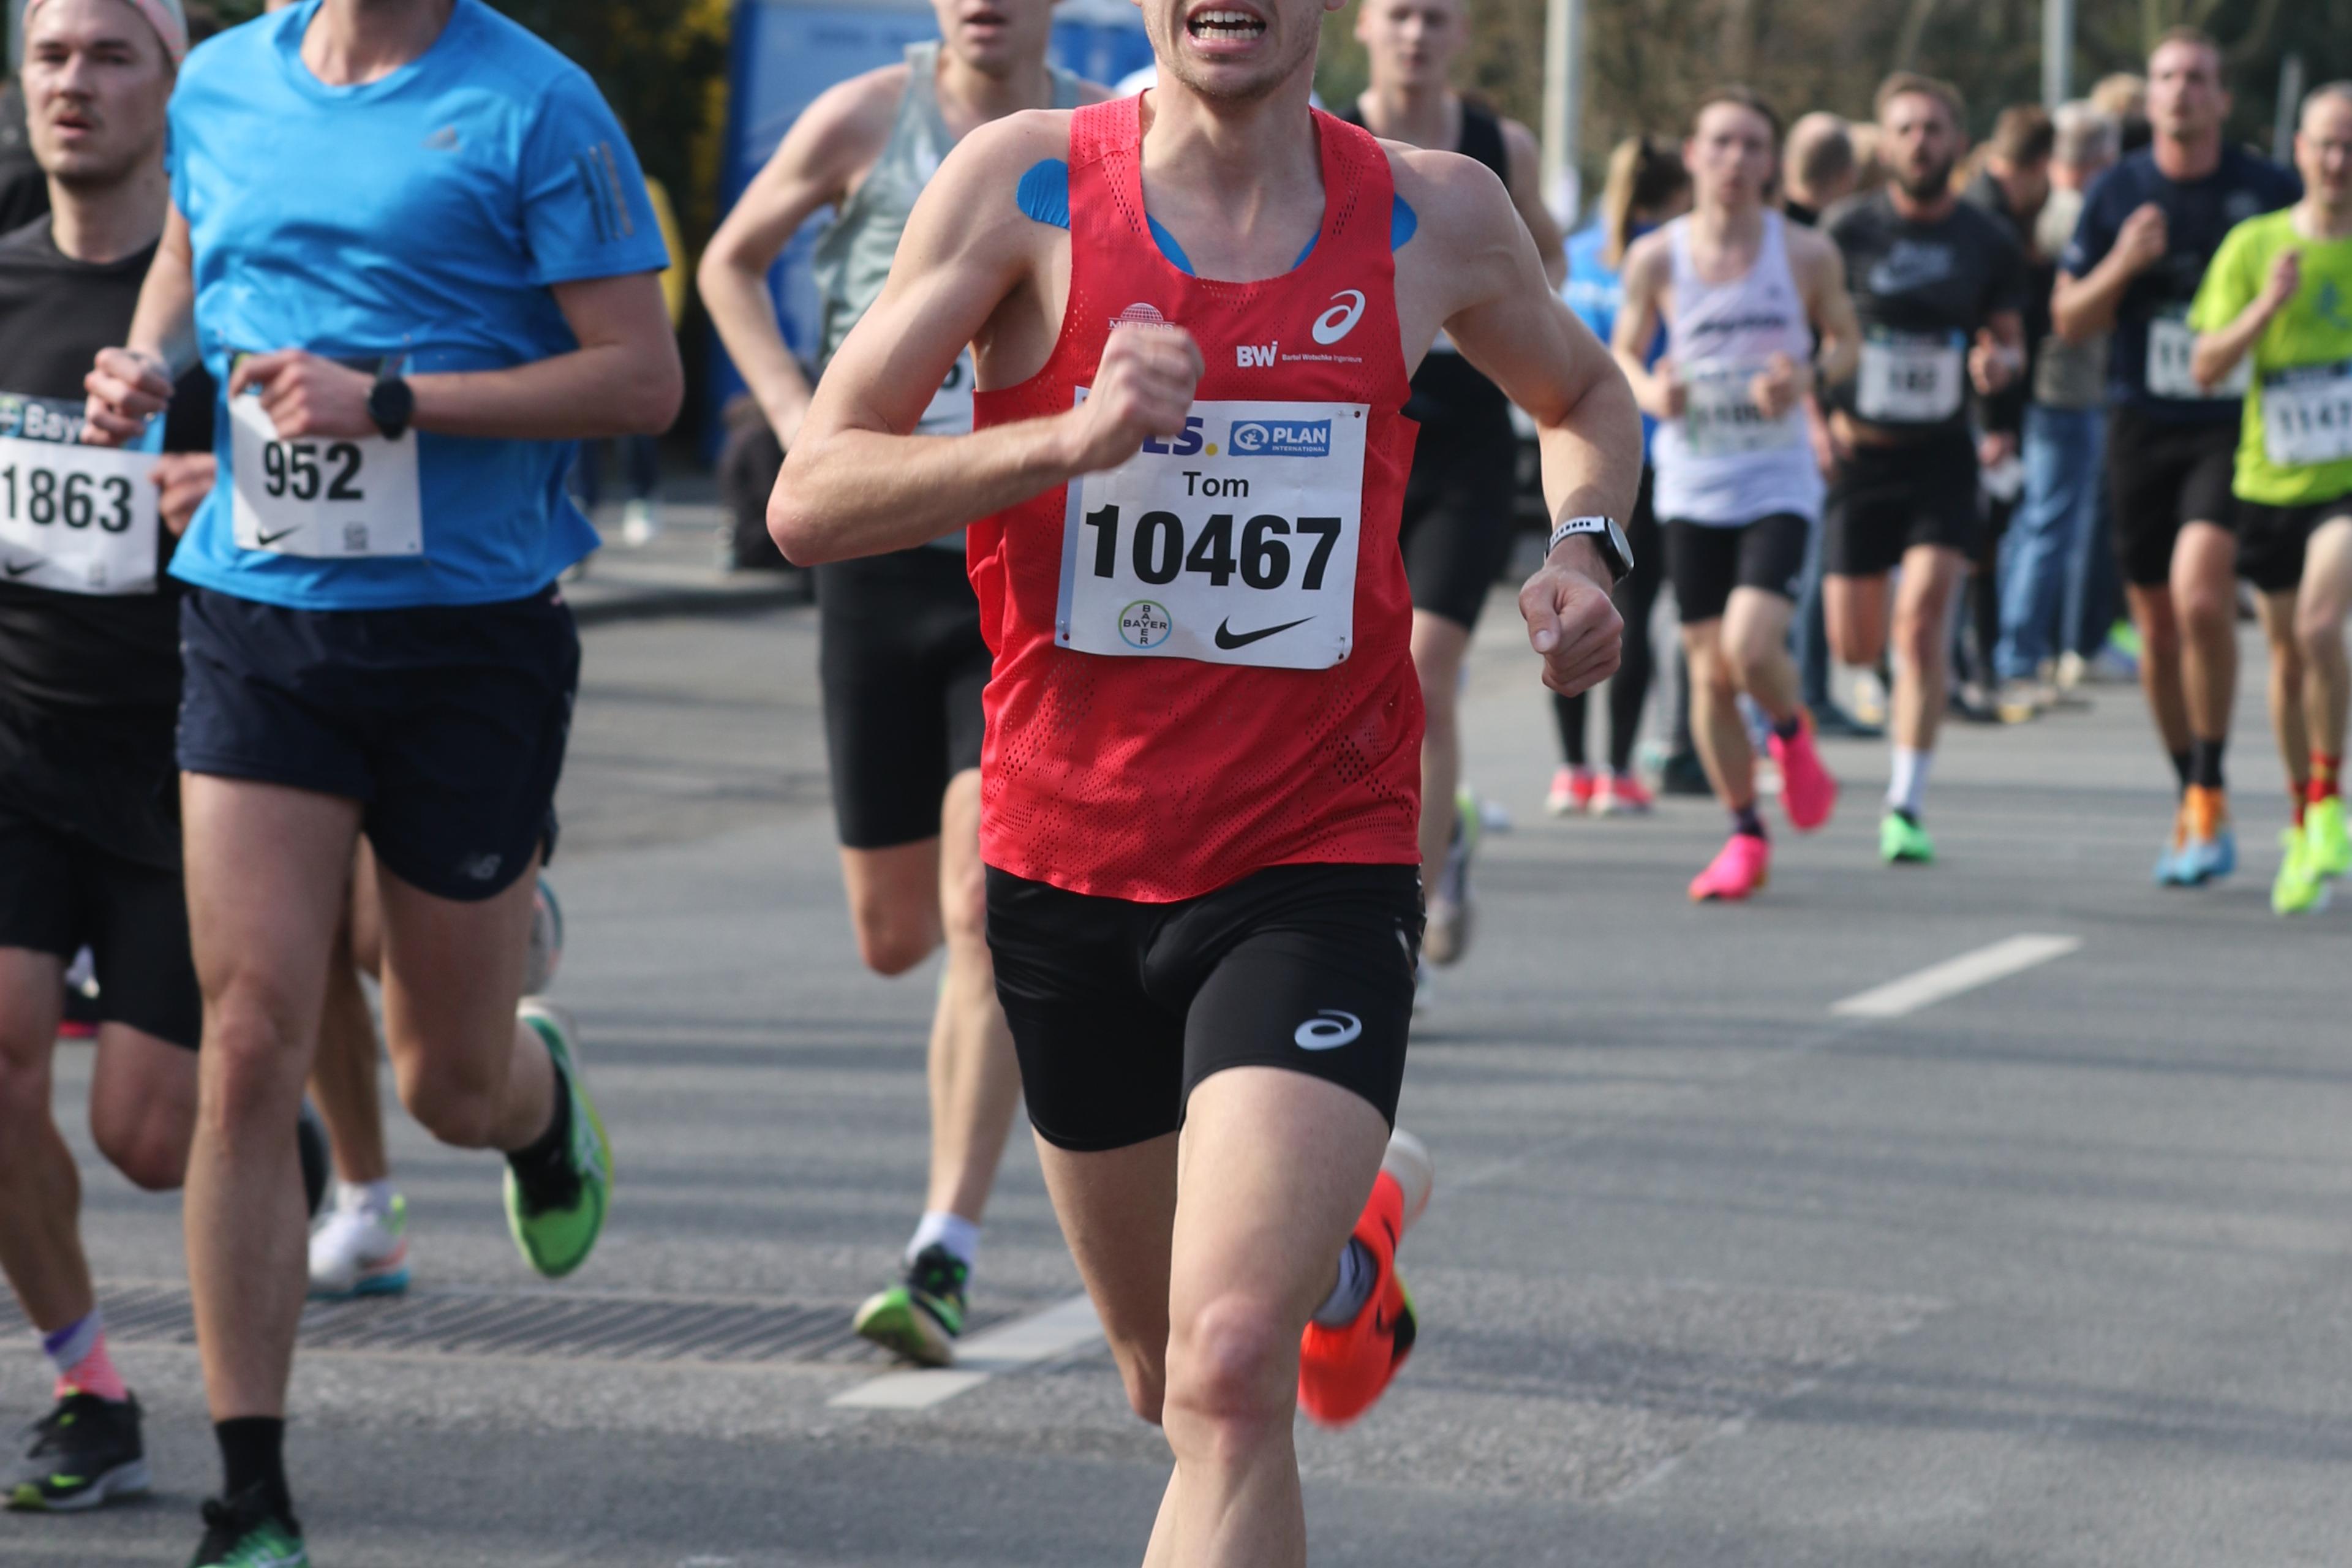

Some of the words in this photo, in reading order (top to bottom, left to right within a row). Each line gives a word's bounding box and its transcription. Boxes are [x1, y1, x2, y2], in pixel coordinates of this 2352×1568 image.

[1273, 428, 1327, 443] PLAN
[265, 442, 363, 500] 952
[1183, 471, 1250, 497] Tom
[2, 464, 132, 533] 1863
[1086, 504, 1342, 590] 10467
[1123, 619, 1168, 630] BAYER
[1140, 605, 1151, 644] BAYER
